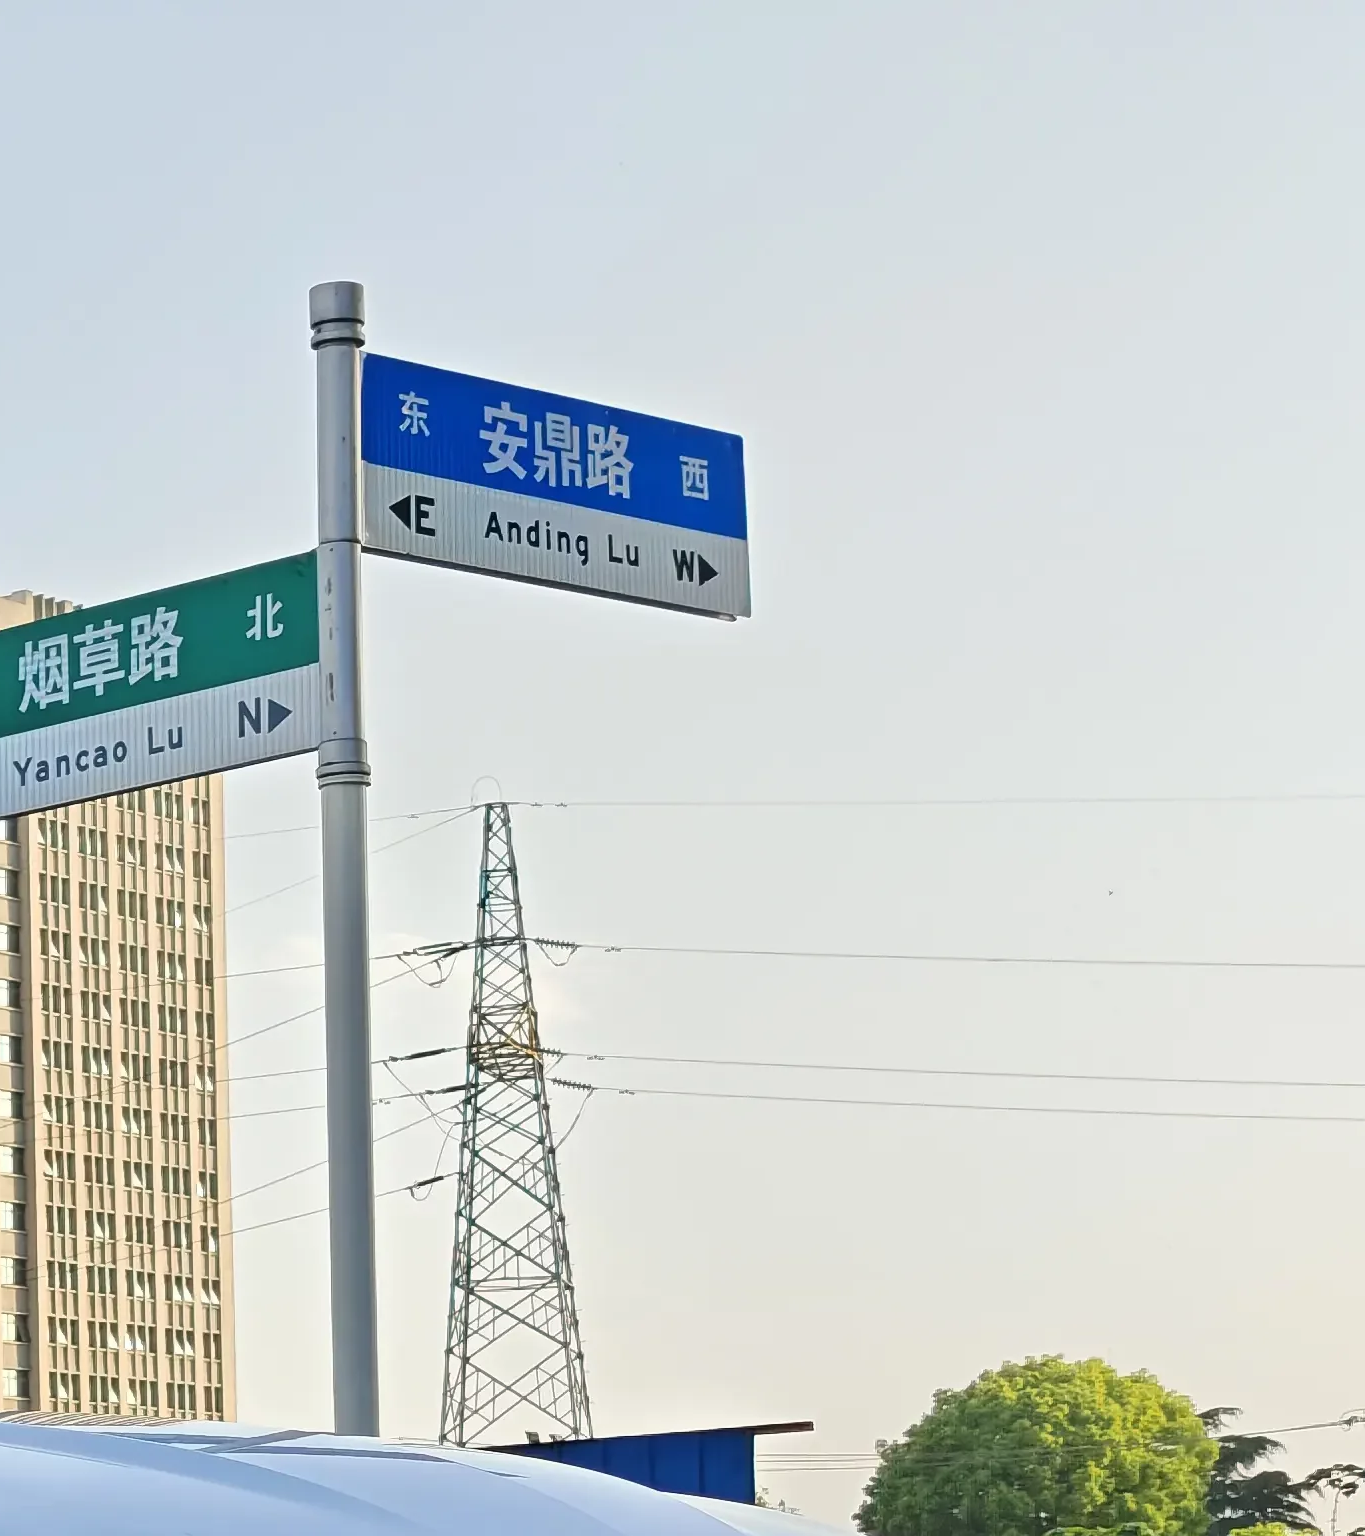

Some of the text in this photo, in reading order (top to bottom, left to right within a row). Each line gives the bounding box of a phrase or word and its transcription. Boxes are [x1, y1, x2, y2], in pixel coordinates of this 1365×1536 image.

[398, 391, 710, 501] 东 安鼎路 西
[415, 494, 695, 583] E Anding Lu W
[17, 606, 184, 713] 烟草路
[245, 592, 284, 641] 北
[12, 740, 128, 787] Yancao
[147, 724, 184, 756] Lu
[237, 696, 262, 739] N
